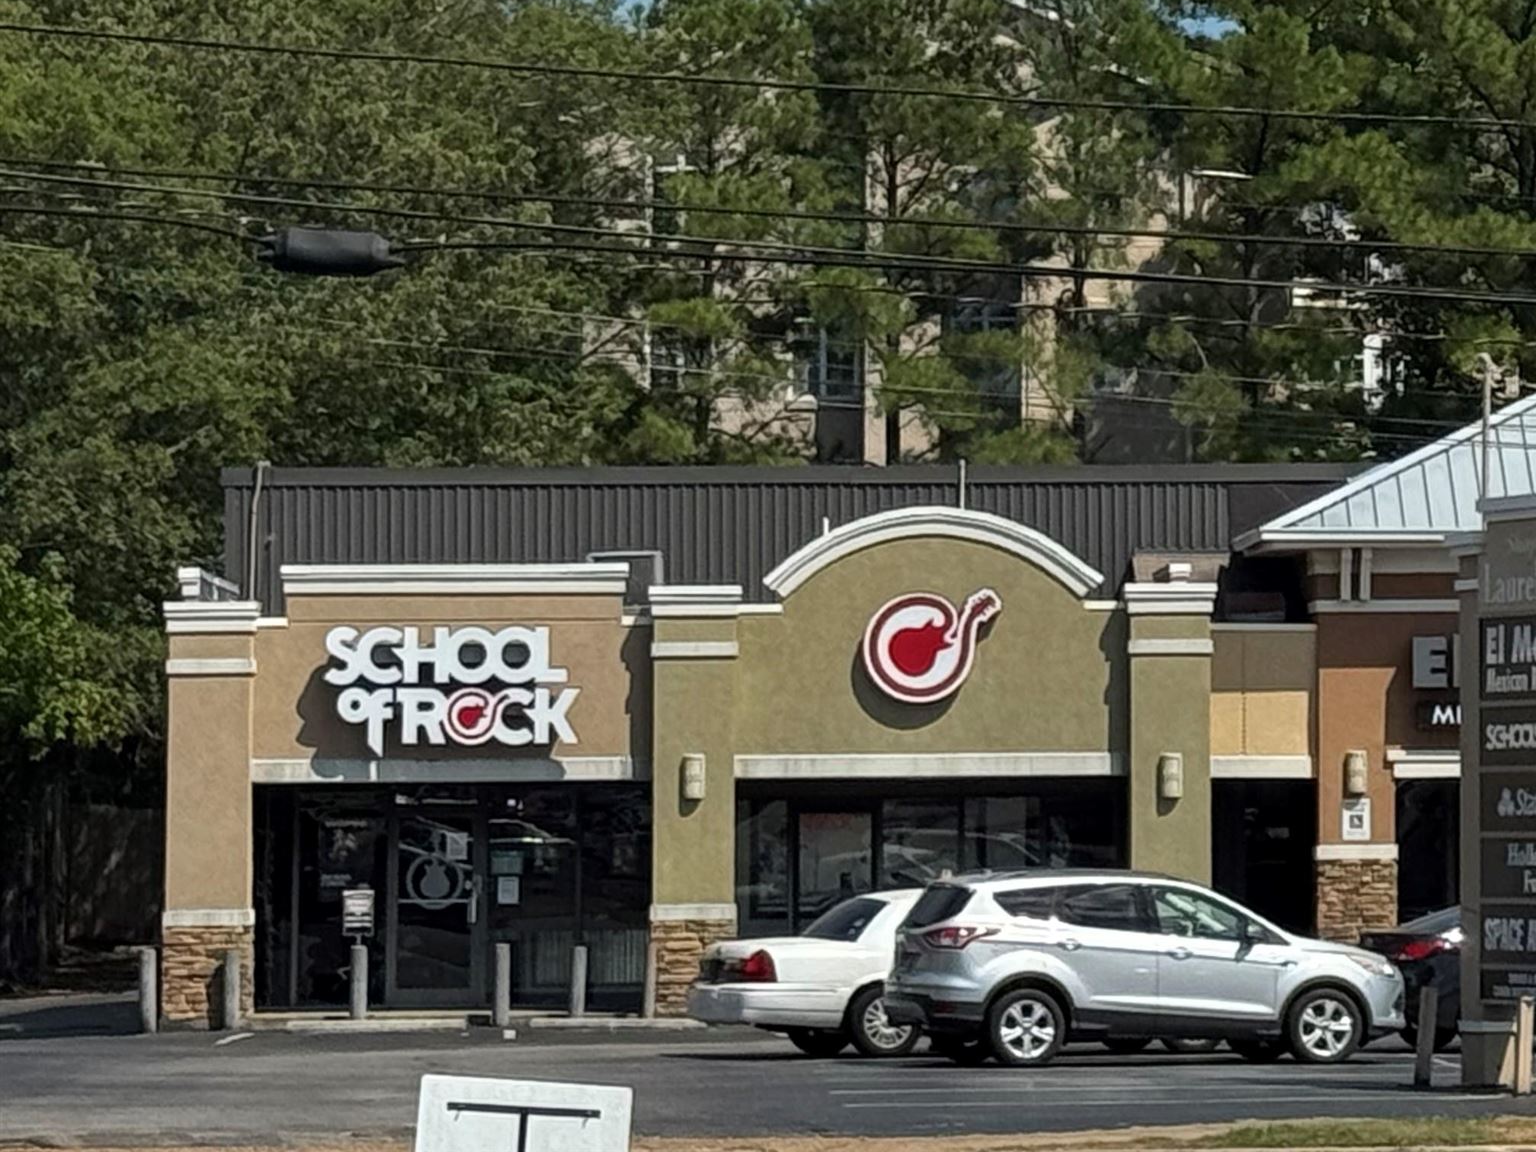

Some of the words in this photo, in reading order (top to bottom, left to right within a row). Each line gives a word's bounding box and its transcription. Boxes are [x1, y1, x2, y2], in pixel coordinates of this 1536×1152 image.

[324, 626, 568, 686] SCHOOL
[1485, 624, 1505, 664] El
[396, 686, 582, 746] ROCK
[1484, 917, 1525, 951] SPACE
